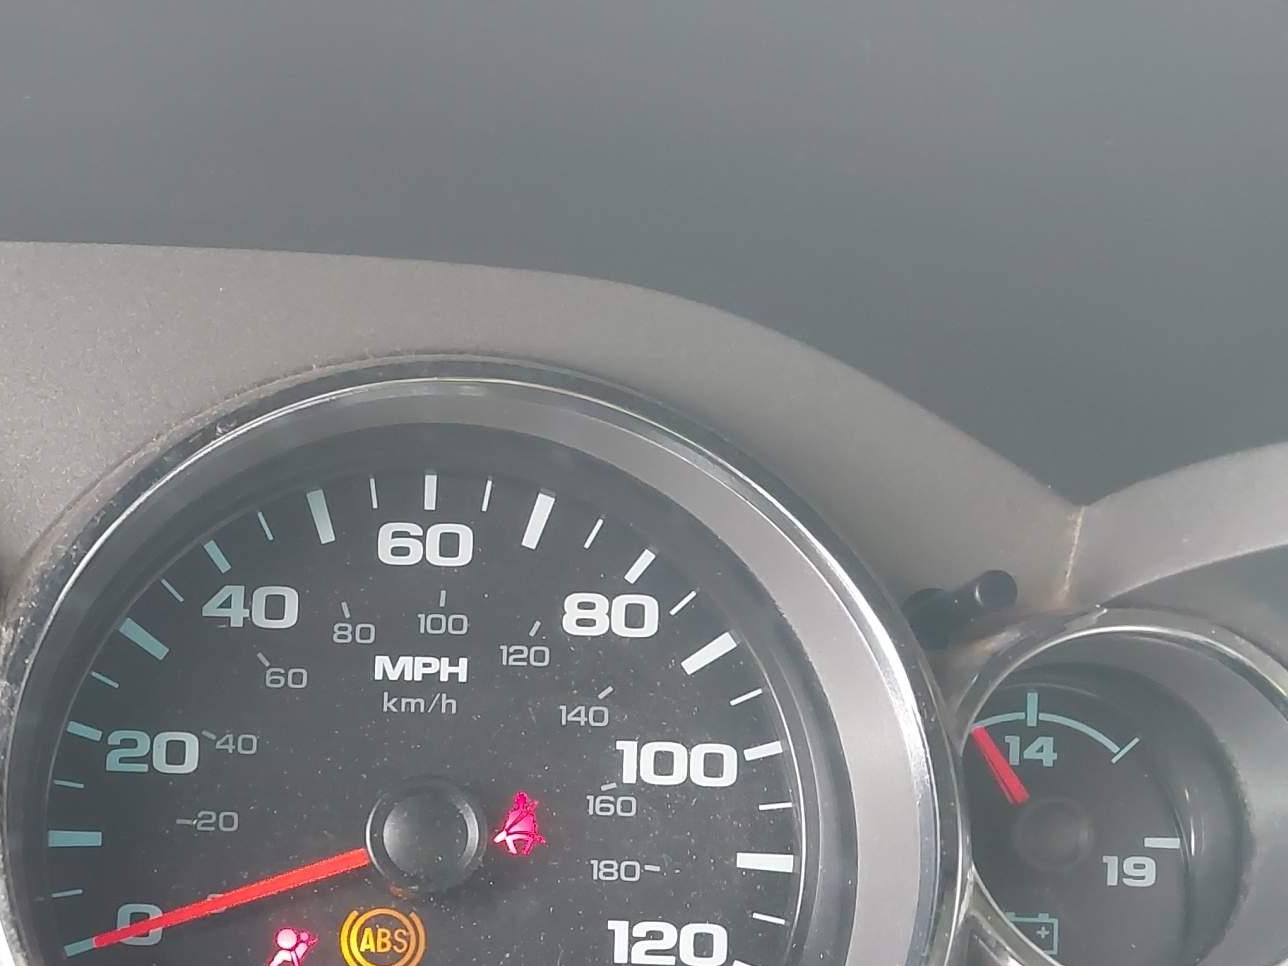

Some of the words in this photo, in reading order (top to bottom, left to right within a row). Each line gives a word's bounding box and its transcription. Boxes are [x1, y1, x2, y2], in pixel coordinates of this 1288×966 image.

[377, 523, 474, 567] 60
[202, 585, 299, 629] 40
[562, 593, 659, 638] 80
[332, 622, 376, 645] 80
[417, 613, 469, 636] 100
[374, 656, 468, 683] MPH
[500, 645, 550, 668] 120
[265, 668, 308, 690] 60
[382, 691, 458, 715] km/h
[559, 705, 609, 728] 140
[106, 730, 200, 773] 20
[215, 733, 258, 755] 40
[1004, 735, 1058, 767] 14
[615, 740, 738, 787] 100
[587, 795, 637, 817] 160
[591, 859, 640, 882] 180
[1102, 855, 1156, 888] 19
[117, 903, 162, 946] 0
[359, 926, 409, 954] ABS
[607, 919, 728, 966] 120
